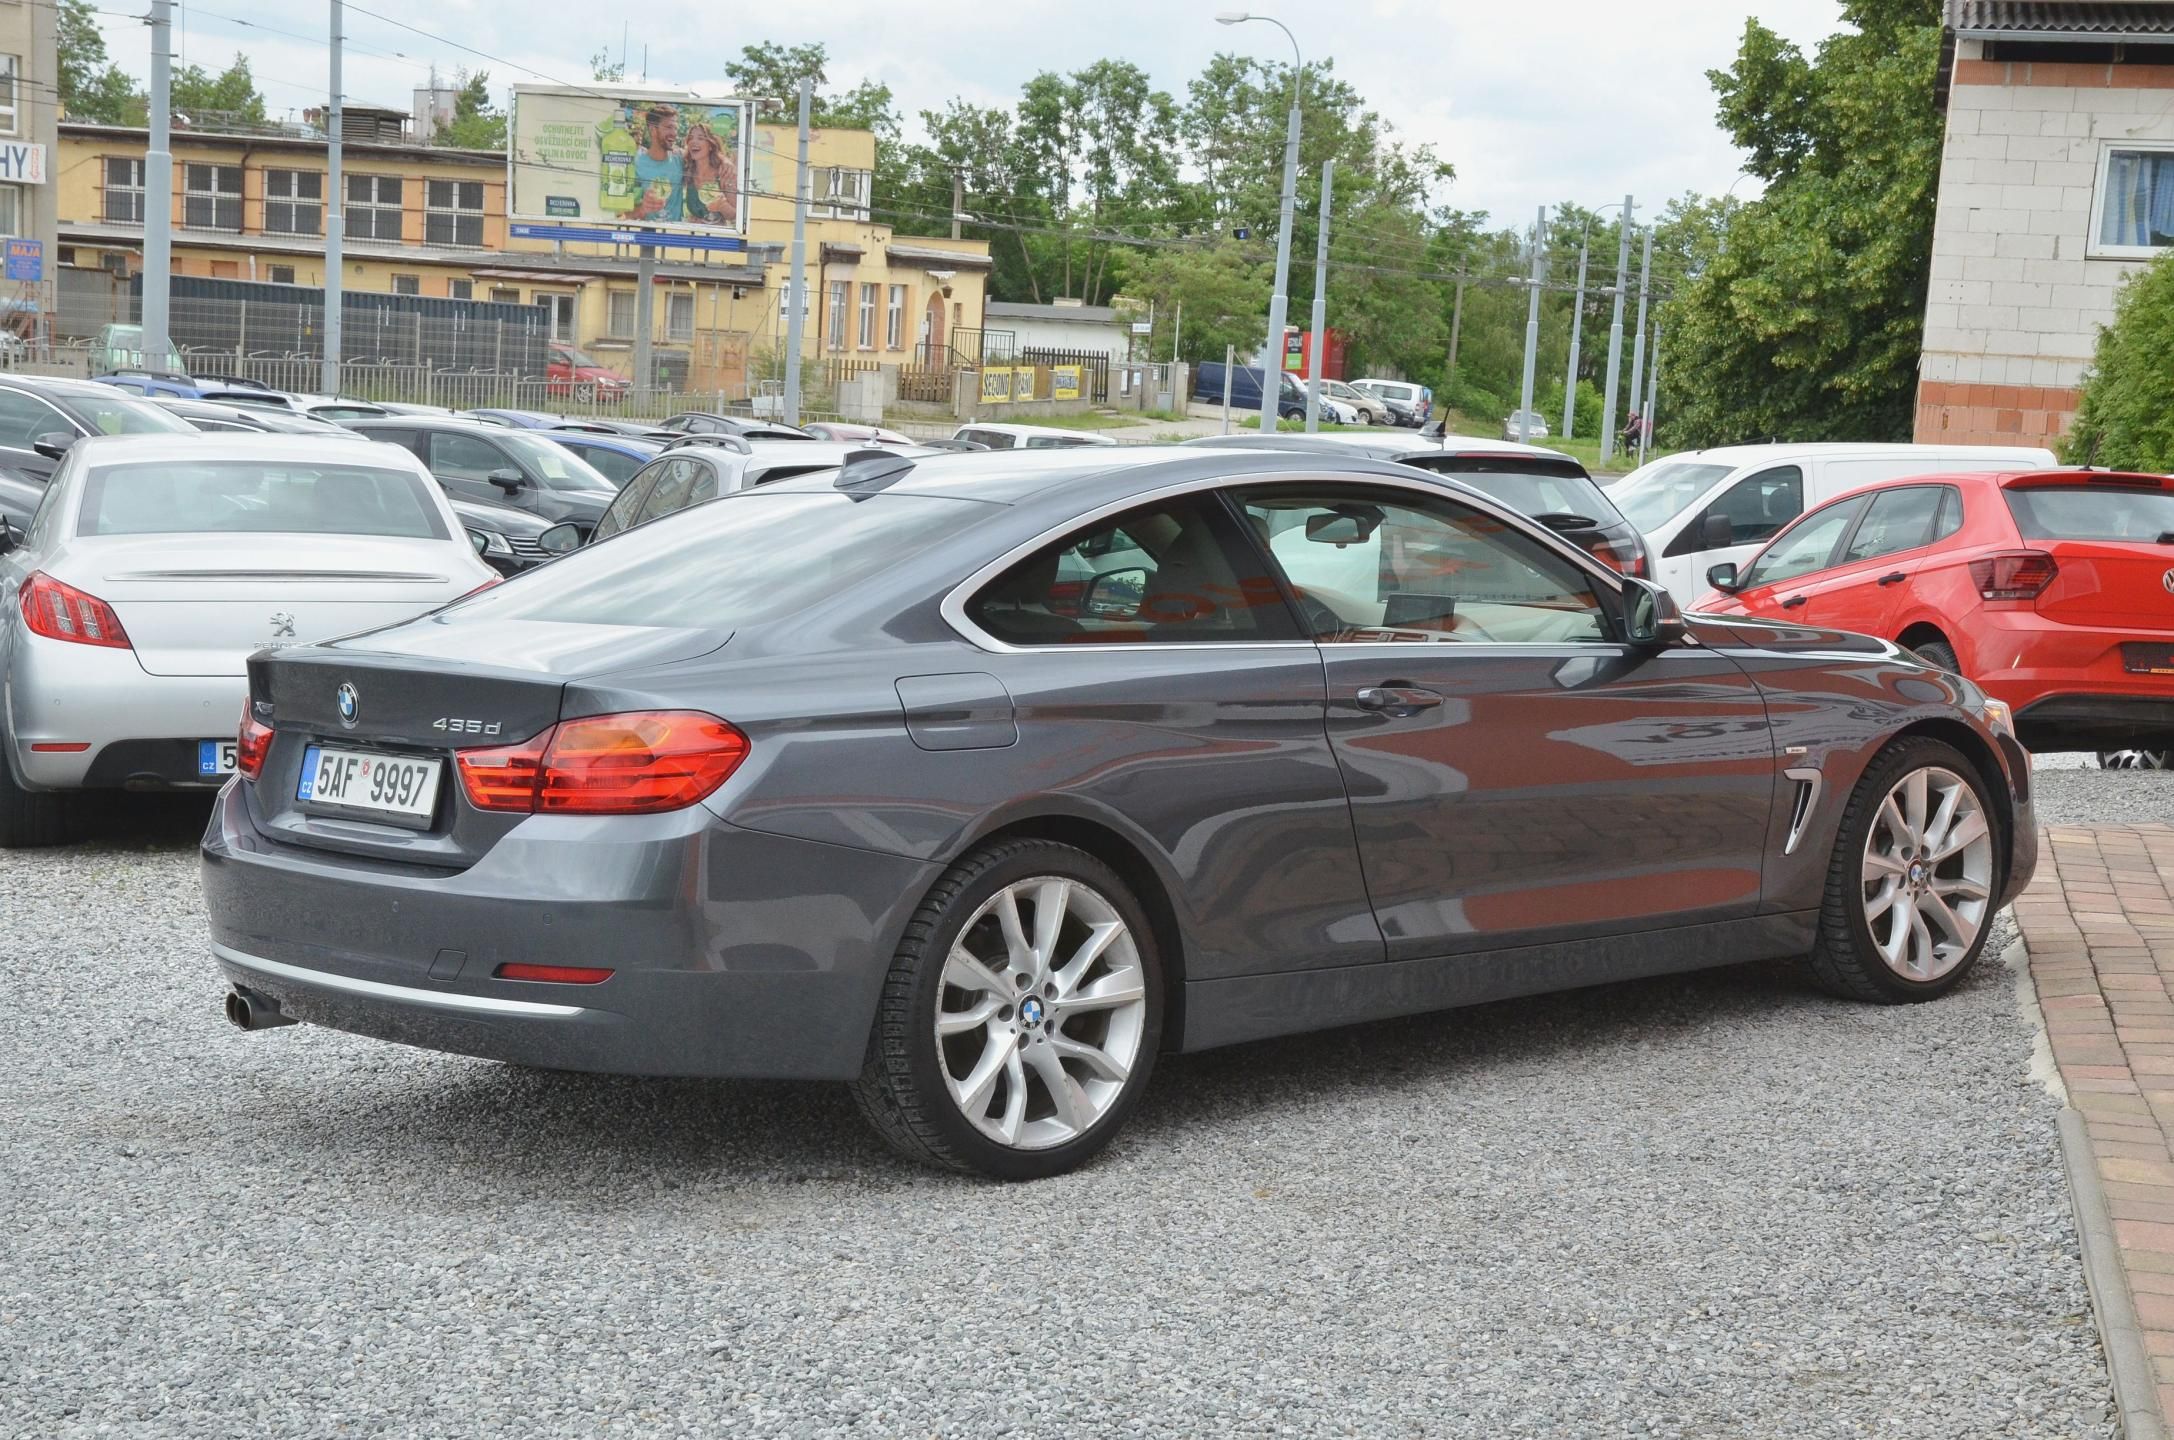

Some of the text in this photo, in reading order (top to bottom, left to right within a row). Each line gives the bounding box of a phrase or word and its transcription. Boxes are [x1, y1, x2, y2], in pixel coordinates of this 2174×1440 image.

[10, 244, 40, 257] MAJA
[983, 373, 1009, 396] SECOND
[432, 717, 502, 735] 435d
[202, 762, 215, 770] CZ
[301, 781, 313, 794] CZ
[317, 755, 429, 807] 5AF 9997
